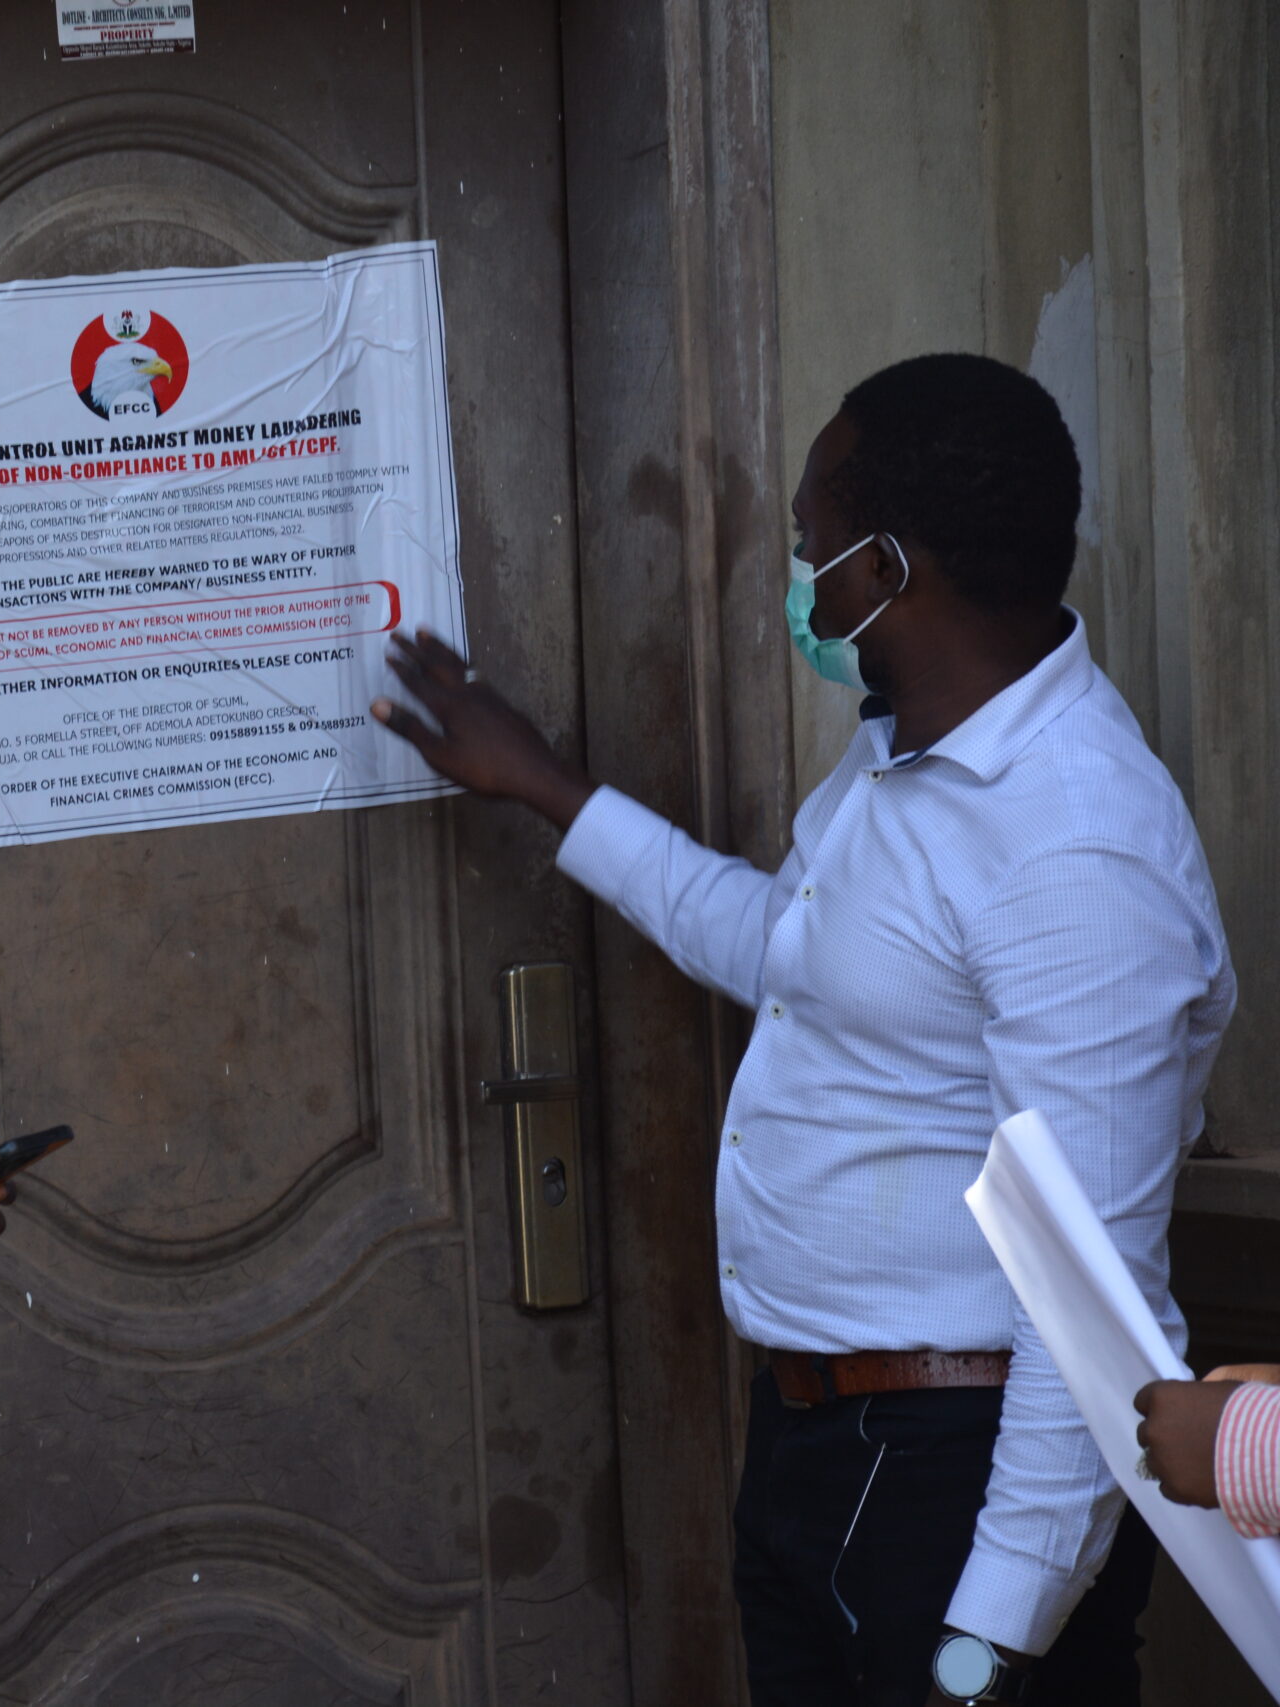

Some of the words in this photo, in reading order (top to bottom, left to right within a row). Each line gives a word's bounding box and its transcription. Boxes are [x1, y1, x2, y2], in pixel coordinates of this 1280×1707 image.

[100, 28, 154, 41] PROPERTY
[114, 403, 150, 415] EFCC
[61, 437, 104, 458] UNIT
[109, 431, 188, 453] AGAINST
[193, 424, 255, 446] MONEY
[24, 454, 186, 484] NON-COMPLIANCE
[191, 452, 215, 470] TO
[69, 499, 83, 510] OF
[86, 496, 108, 508] THIS
[110, 492, 158, 506] COMPANY
[161, 489, 180, 500] AND
[181, 482, 224, 498] BUSINESS
[227, 479, 273, 493] PREMISES
[275, 476, 299, 489] HAVE
[302, 472, 333, 486] FAILED
[335, 470, 345, 483] TO
[344, 466, 377, 480] COMPLY
[380, 464, 409, 476] WITH
[29, 514, 85, 530] COMBATING
[89, 512, 107, 524] THE
[112, 506, 164, 522] FINANCING
[167, 504, 180, 516] OF
[182, 498, 233, 514] TERRORISM
[235, 497, 255, 508] AND
[257, 490, 319, 507] COUNTERING
[36, 533, 50, 544] OF
[52, 531, 77, 545] MASS
[80, 524, 150, 541] DESTRUCTION
[152, 521, 171, 534] FOR
[173, 515, 229, 531] DESIGNATED
[231, 508, 302, 525] NON-FINANCIAL
[66, 546, 86, 560] AND
[89, 542, 123, 555] OTHER
[125, 538, 167, 553] RELATED
[169, 533, 208, 547] MATTERS
[210, 526, 276, 543] REGULATIONS,
[280, 523, 304, 536] 2022.
[0, 579, 25, 592] THE
[28, 574, 73, 589] PUBLIC
[76, 571, 101, 583] ARE
[104, 566, 155, 582] HEREBY
[158, 561, 209, 576] WARNED
[212, 559, 229, 570] TO
[232, 557, 247, 568] BE
[250, 552, 287, 566] WARY
[290, 550, 307, 562] OF
[310, 544, 356, 560] FURTHER
[70, 587, 105, 600] WITH
[108, 584, 132, 597] THE
[135, 577, 201, 595] COMPANY/
[205, 571, 266, 588] BUSINESS
[268, 565, 316, 581] ENTITY.
[7, 630, 30, 643] NOT
[32, 629, 44, 640] BE
[46, 622, 99, 638] REMOVED
[102, 621, 114, 632] BY
[117, 618, 140, 630] ANY
[143, 614, 183, 628] PERSON
[186, 609, 231, 623] WITHOUT
[233, 607, 252, 619] THE
[254, 603, 285, 617] PRIOR
[287, 598, 341, 613] AUTHORITY
[344, 595, 353, 608] OF
[354, 594, 370, 606] THE
[55, 638, 116, 655] ECONOMIC
[119, 636, 143, 647] AND
[146, 630, 201, 644] FINANCIAL
[204, 626, 242, 640] CRIMES
[245, 619, 316, 635] COMMISSION
[40, 669, 138, 690] INFORMATION
[141, 667, 160, 680] OR
[164, 658, 241, 677] ENQUIRIES
[242, 654, 290, 670] PLEASE
[293, 647, 354, 665] CONTACT:
[62, 711, 99, 724] OFFICE
[101, 709, 116, 721] OF
[119, 707, 138, 719] THE
[142, 701, 192, 716] DIRECTOR
[195, 698, 209, 711] OF
[212, 695, 248, 709] SCUML,
[15, 736, 21, 748] 5
[24, 730, 77, 746] FORMELLA
[79, 724, 120, 740] STREET,
[122, 722, 141, 736] OFF
[144, 717, 192, 733] ADEMOLA
[195, 709, 264, 727] ADETOKUNBO
[23, 750, 38, 762] OR
[41, 747, 66, 760] CALL
[69, 744, 89, 757] THE
[91, 738, 152, 754] FOLLOWING
[155, 732, 206, 748] NUMBERS:
[209, 724, 285, 741] 09158891155
[287, 722, 295, 732] &
[299, 716, 365, 732] 09158893271
[0, 781, 37, 795] ORDER
[40, 778, 56, 790] OF
[58, 775, 78, 788] THE
[80, 769, 138, 786] EXECUTIVE
[141, 762, 203, 779] CHAIRMAN
[206, 760, 221, 772] OF
[223, 758, 243, 770] THE
[245, 750, 309, 767] ECONOMIC
[312, 748, 337, 759] AND
[49, 791, 110, 807] FINANCIAL
[112, 786, 154, 800] CRIMES
[157, 777, 231, 795] COMMISSION
[234, 772, 275, 787] (EFCC).
